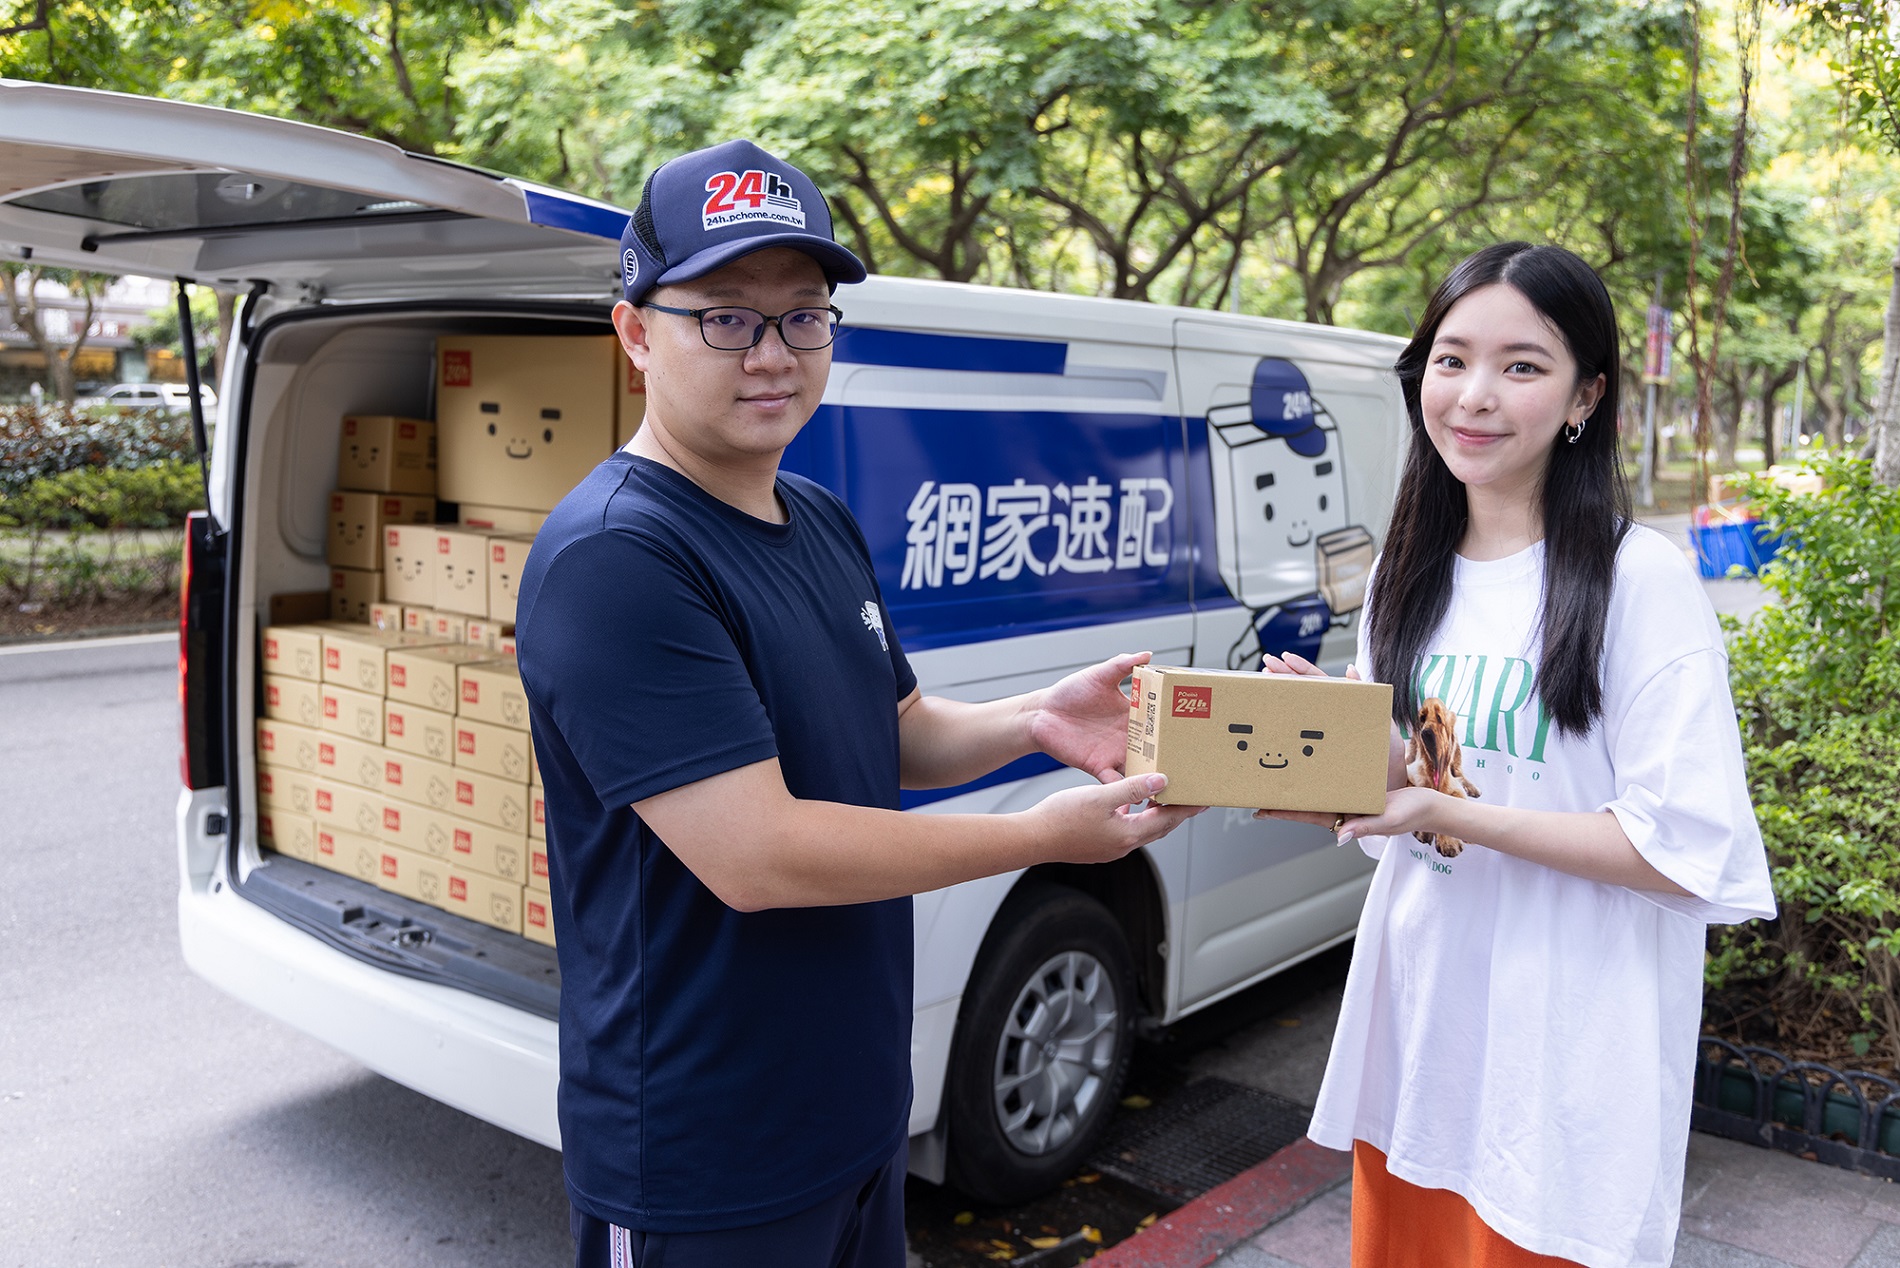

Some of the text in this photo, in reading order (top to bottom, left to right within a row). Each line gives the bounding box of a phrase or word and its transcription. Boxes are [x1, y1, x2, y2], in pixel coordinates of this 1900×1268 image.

[705, 171, 793, 216] 24h
[706, 210, 804, 228] 24h.pchome.com.tw
[901, 476, 1174, 590] 網家速配
[1174, 698, 1208, 713] 24h
[1431, 860, 1453, 876] DOG
